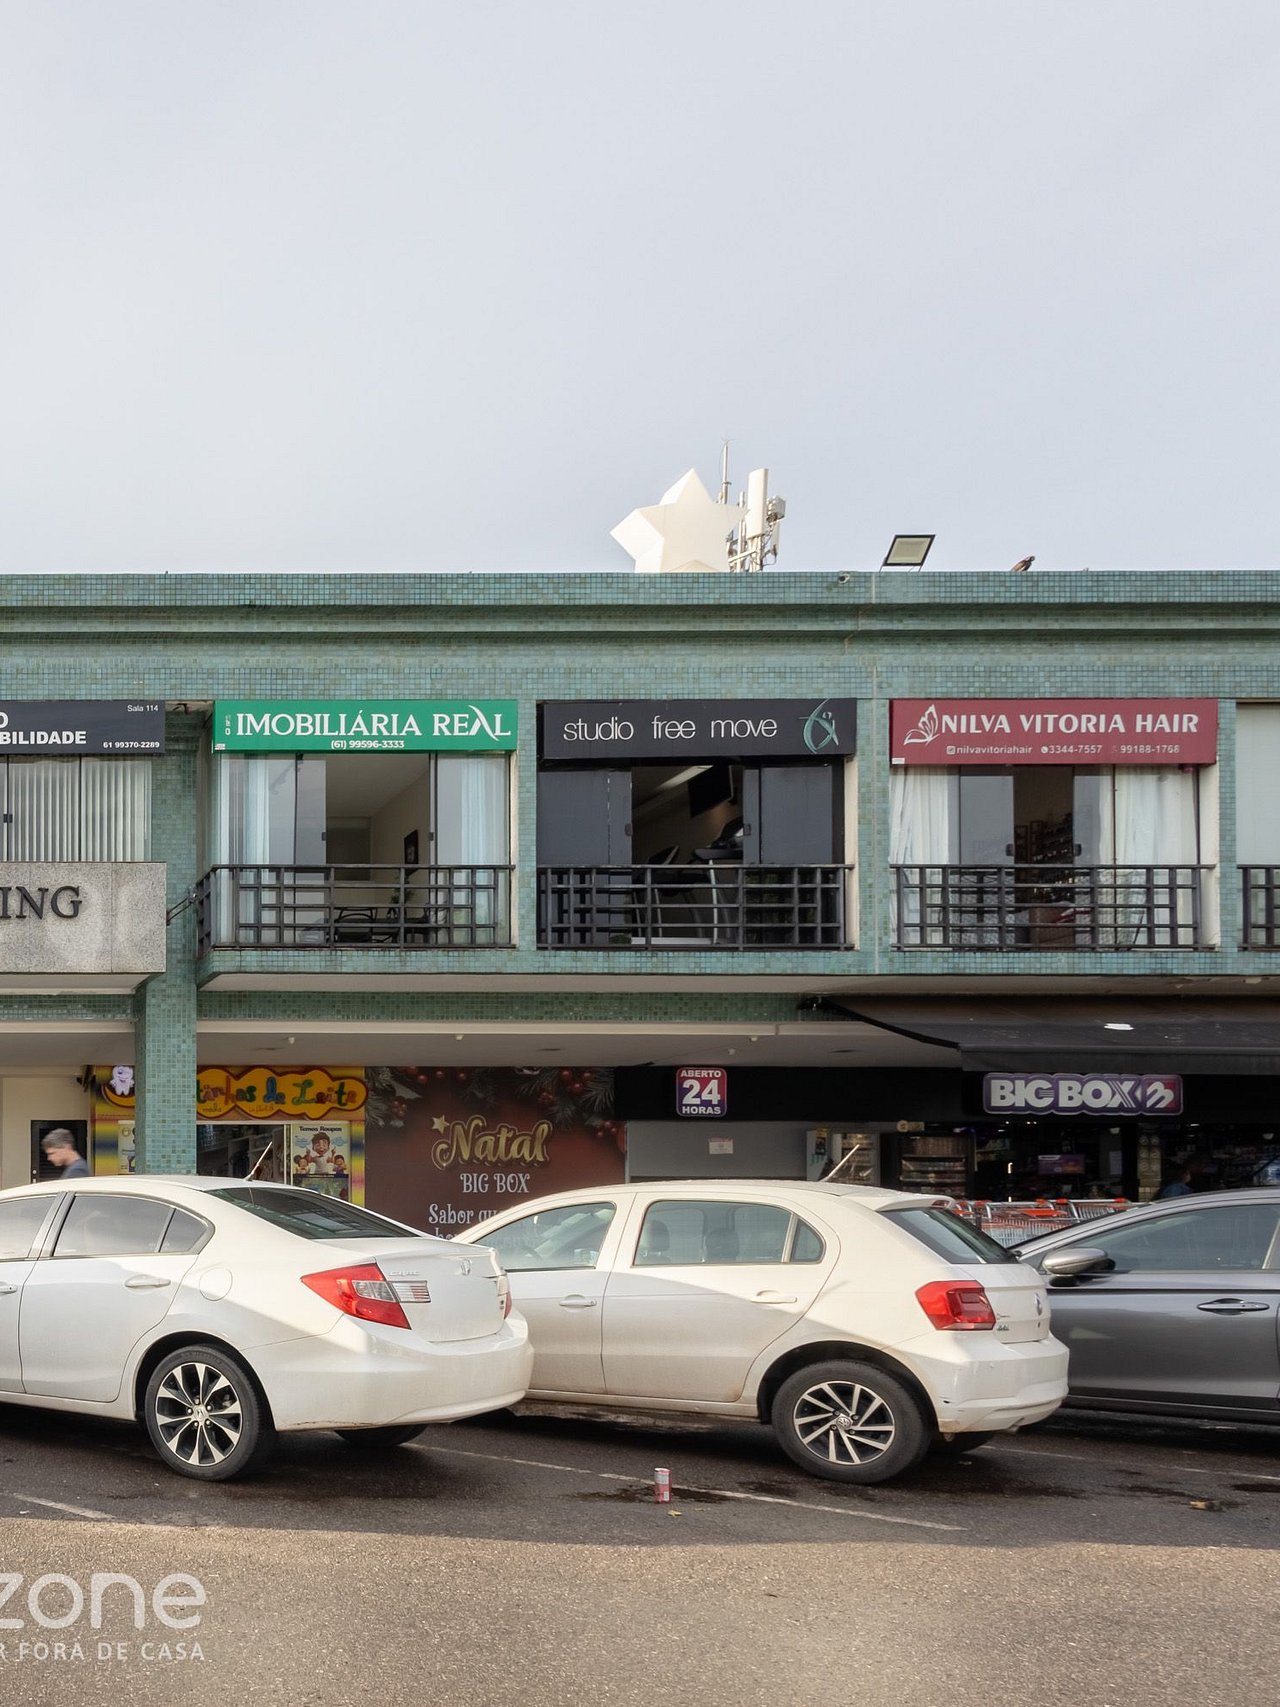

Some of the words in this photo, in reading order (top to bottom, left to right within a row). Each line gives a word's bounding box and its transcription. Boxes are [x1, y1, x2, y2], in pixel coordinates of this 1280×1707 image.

[127, 704, 144, 713] Sala
[146, 704, 159, 713] 114
[236, 710, 422, 737] IMOBILIÁRIA
[432, 705, 511, 742] REAL
[563, 716, 634, 741] studio
[651, 715, 696, 740] free
[710, 718, 778, 738] move
[941, 714, 1011, 734] NILVA
[1020, 714, 1125, 734] VITORIA
[1135, 714, 1199, 733] HAIR
[103, 741, 113, 749] 61
[115, 741, 160, 749] 99370-2289
[331, 740, 347, 750] (61)
[349, 740, 405, 749] 99596-3333
[1048, 745, 1102, 754] 3344-7557
[680, 1069, 722, 1079] ABERTO
[682, 1079, 721, 1105] 24
[990, 1080, 1056, 1108] BIG
[1058, 1080, 1136, 1108] BOX
[682, 1106, 721, 1115] HORAS
[434, 1116, 551, 1168] Natal
[460, 1173, 489, 1193] BIG
[493, 1173, 530, 1193] BOX
[428, 1203, 474, 1224] Sabor
